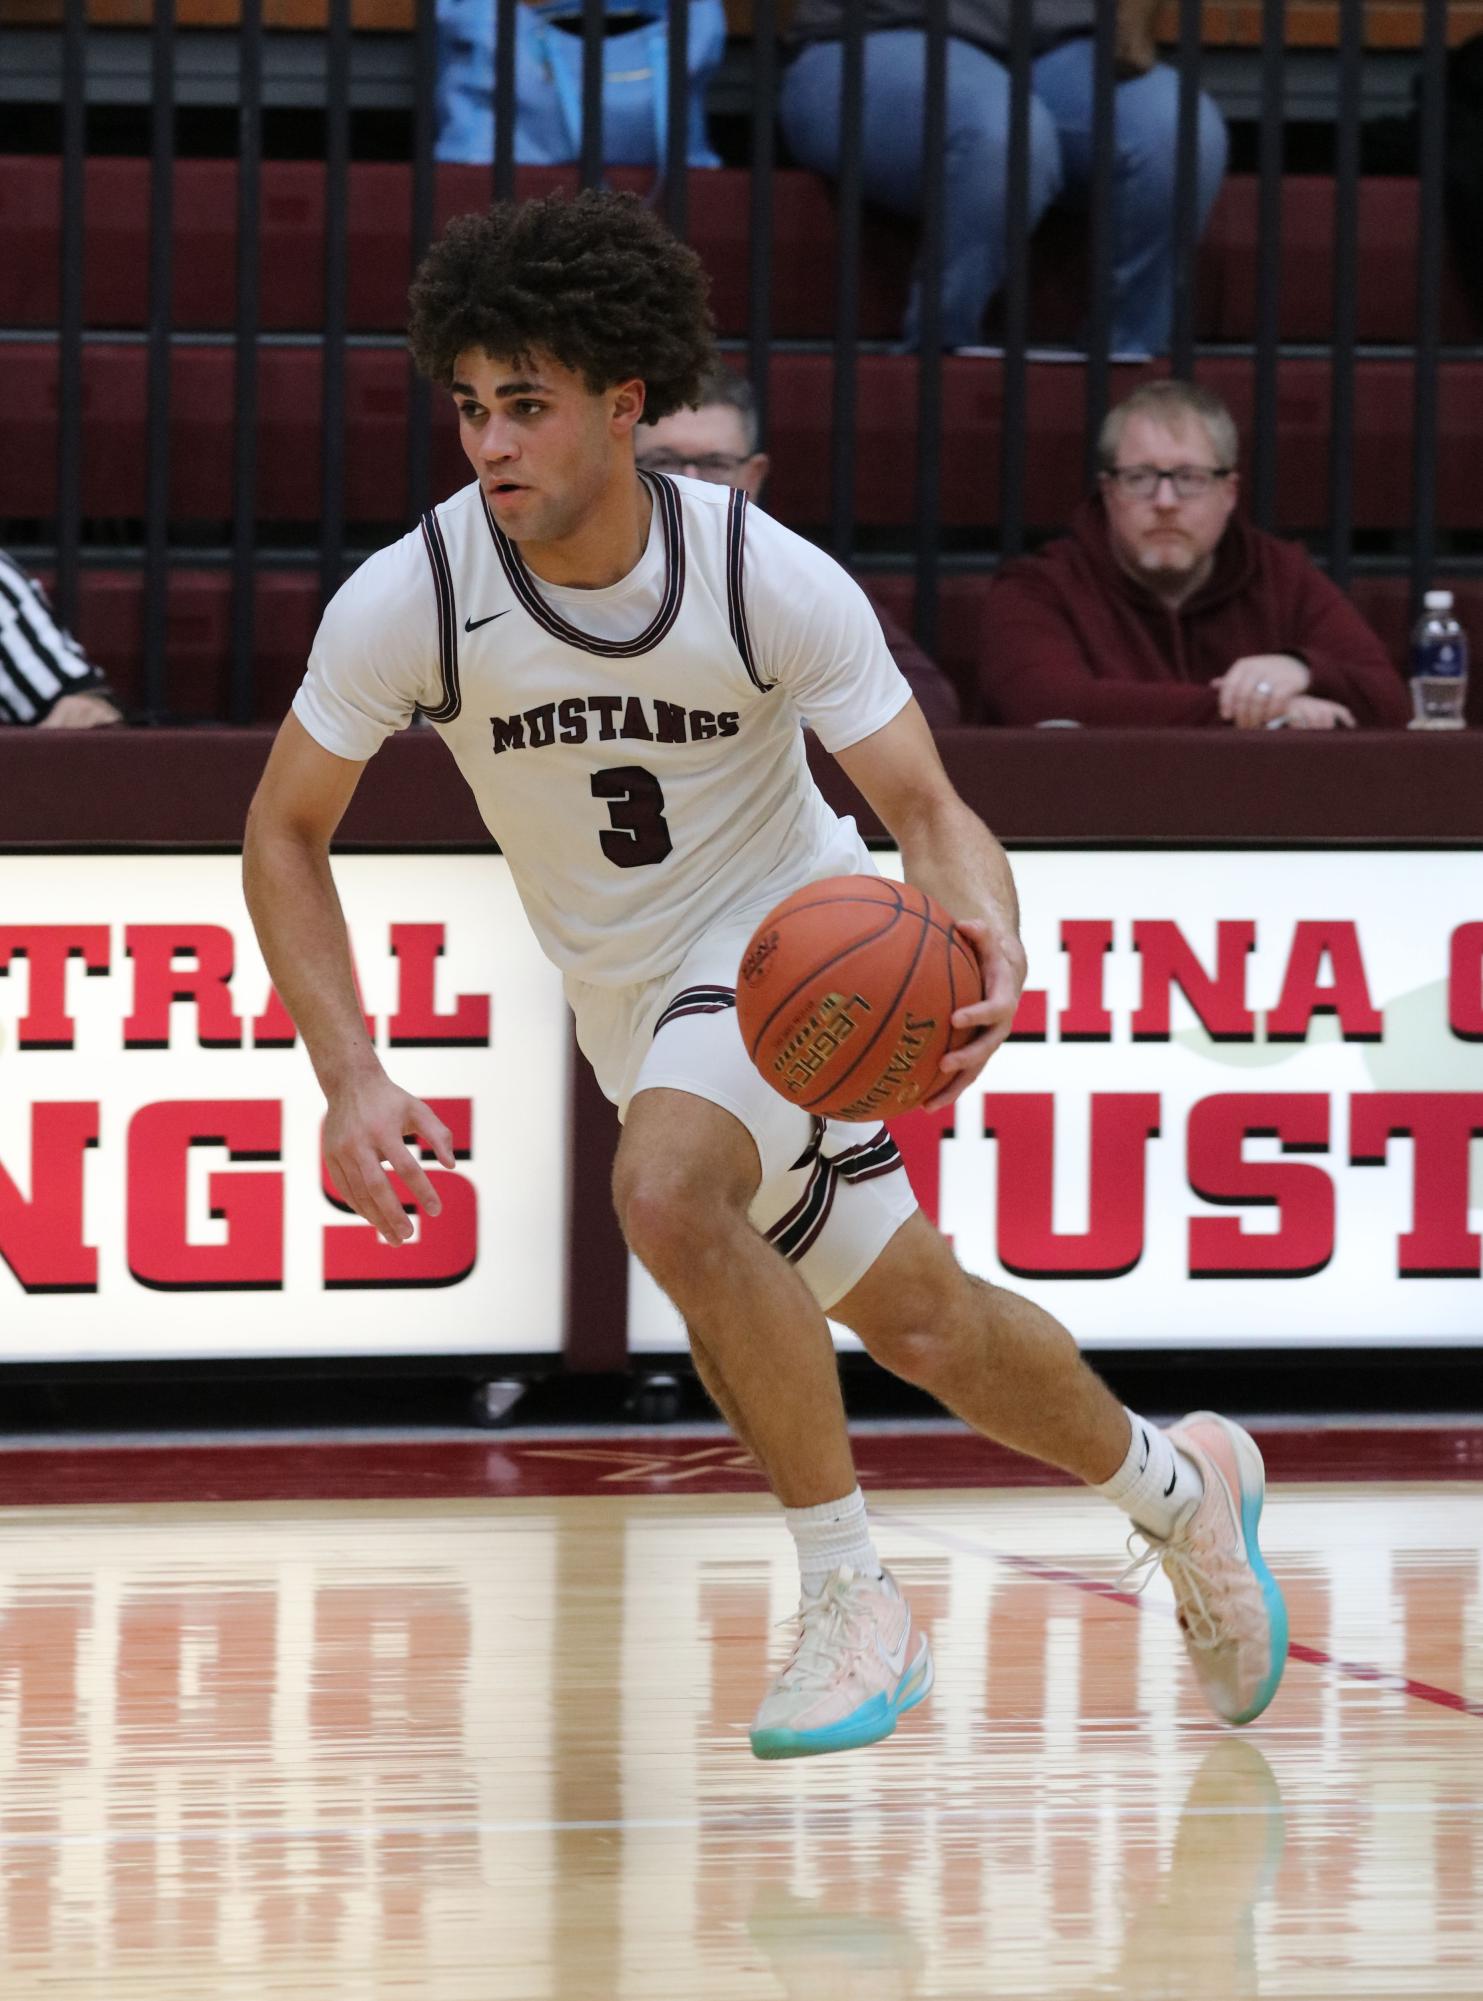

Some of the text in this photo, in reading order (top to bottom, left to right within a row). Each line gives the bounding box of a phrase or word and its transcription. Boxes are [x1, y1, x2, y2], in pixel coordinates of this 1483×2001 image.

[489, 695, 741, 755] MUSTANGS
[590, 765, 674, 868] 3
[782, 993, 872, 1094] LEGACY
